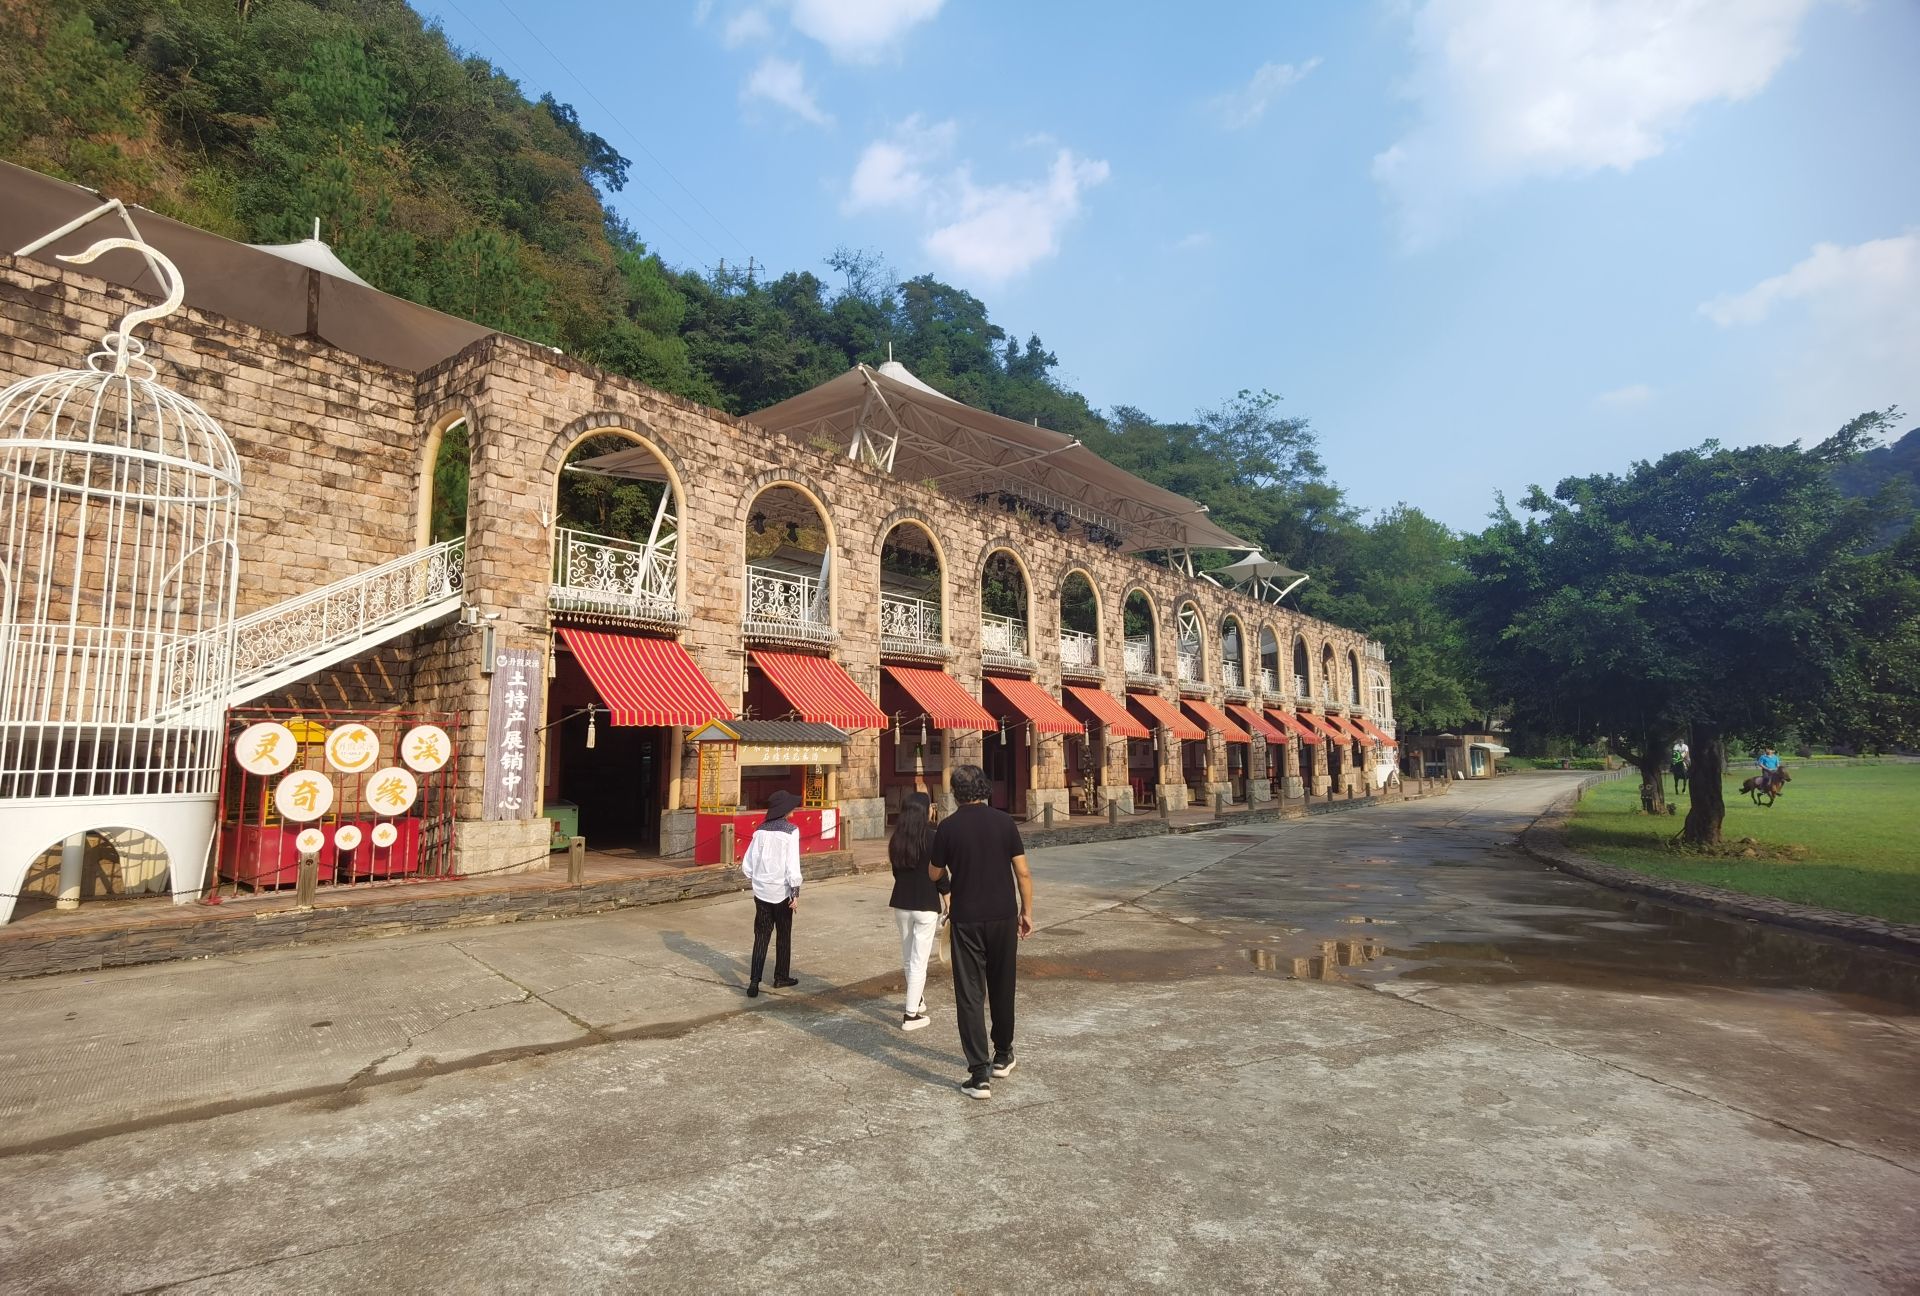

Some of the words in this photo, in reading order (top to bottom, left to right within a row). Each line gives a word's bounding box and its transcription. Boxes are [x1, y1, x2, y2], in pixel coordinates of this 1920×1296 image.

[251, 732, 281, 766] 灵
[412, 733, 442, 764] 溪
[499, 670, 528, 810] 土特产展销中心
[291, 779, 321, 812] 奇
[375, 777, 408, 806] 缘
